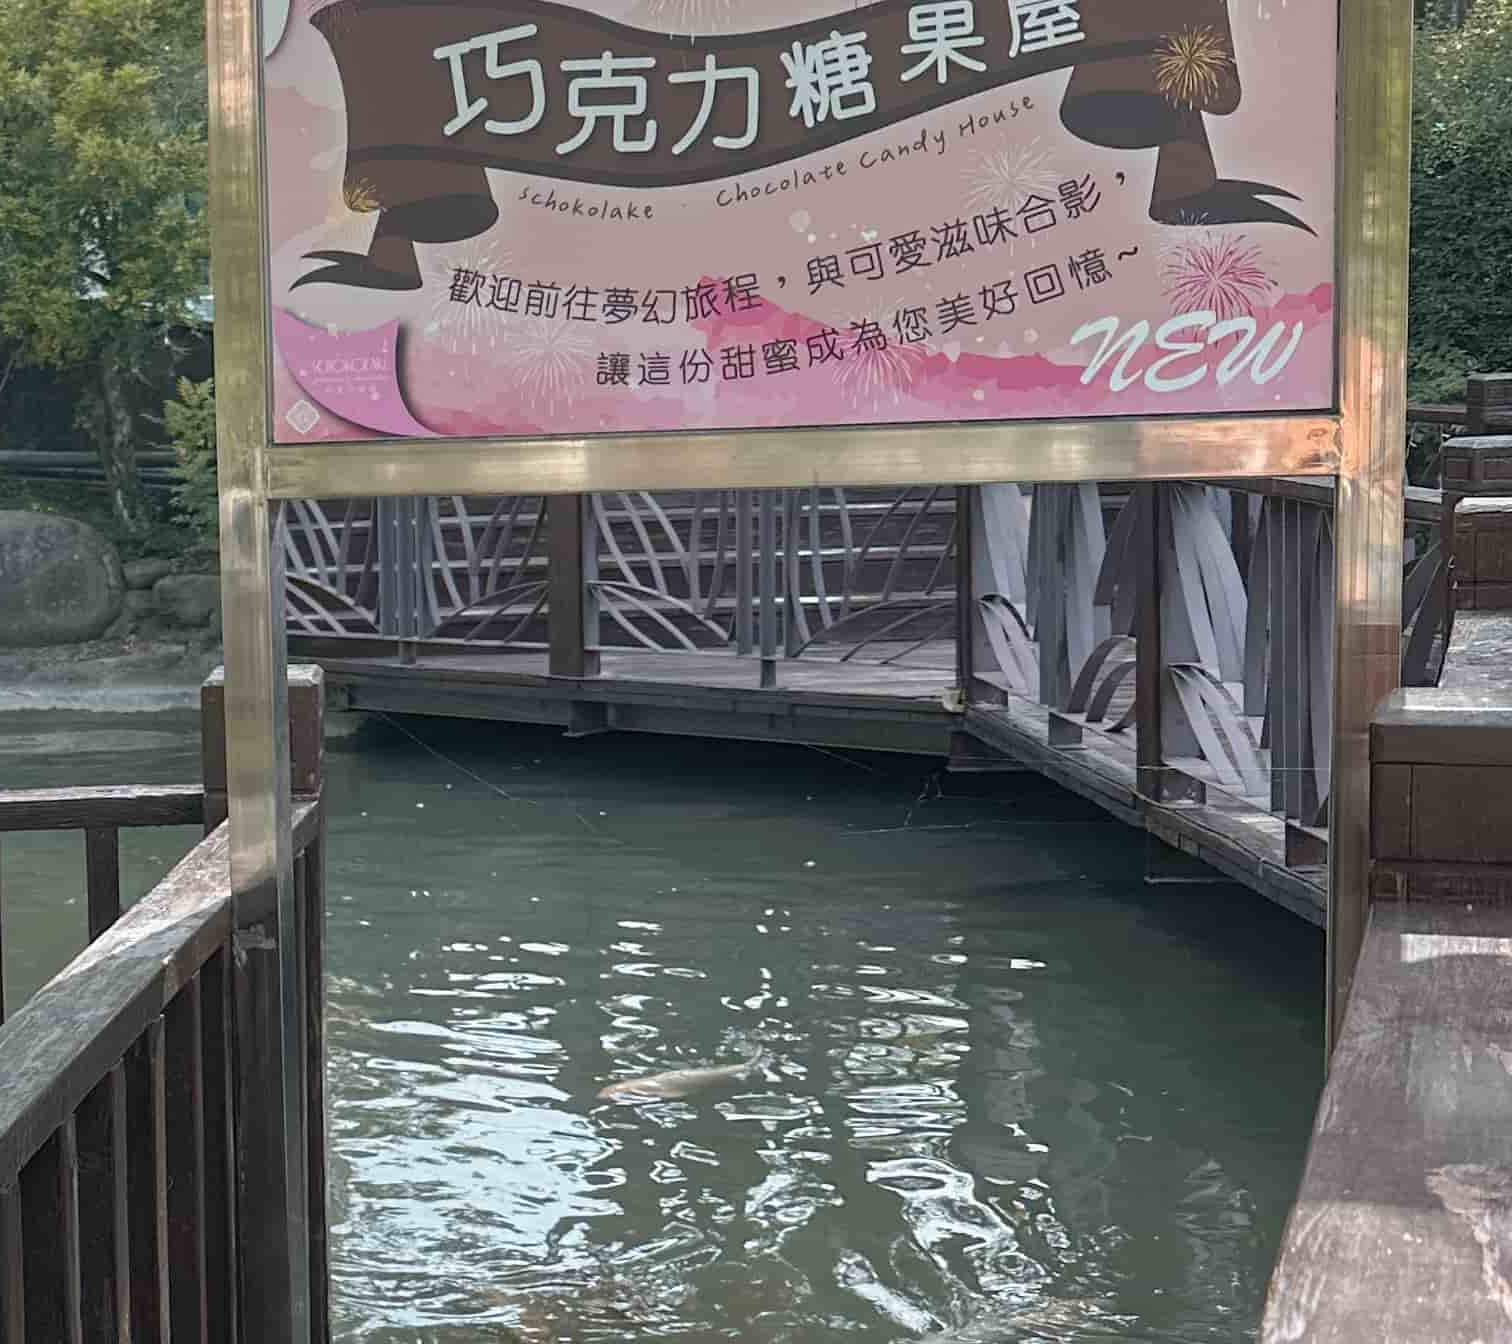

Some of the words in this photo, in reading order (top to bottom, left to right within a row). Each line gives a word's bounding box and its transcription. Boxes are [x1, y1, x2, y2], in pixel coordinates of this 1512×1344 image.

[715, 161, 848, 208] Chocolate
[859, 128, 947, 169] Candy
[958, 94, 1035, 138] House
[1069, 309, 1305, 393] NEW
